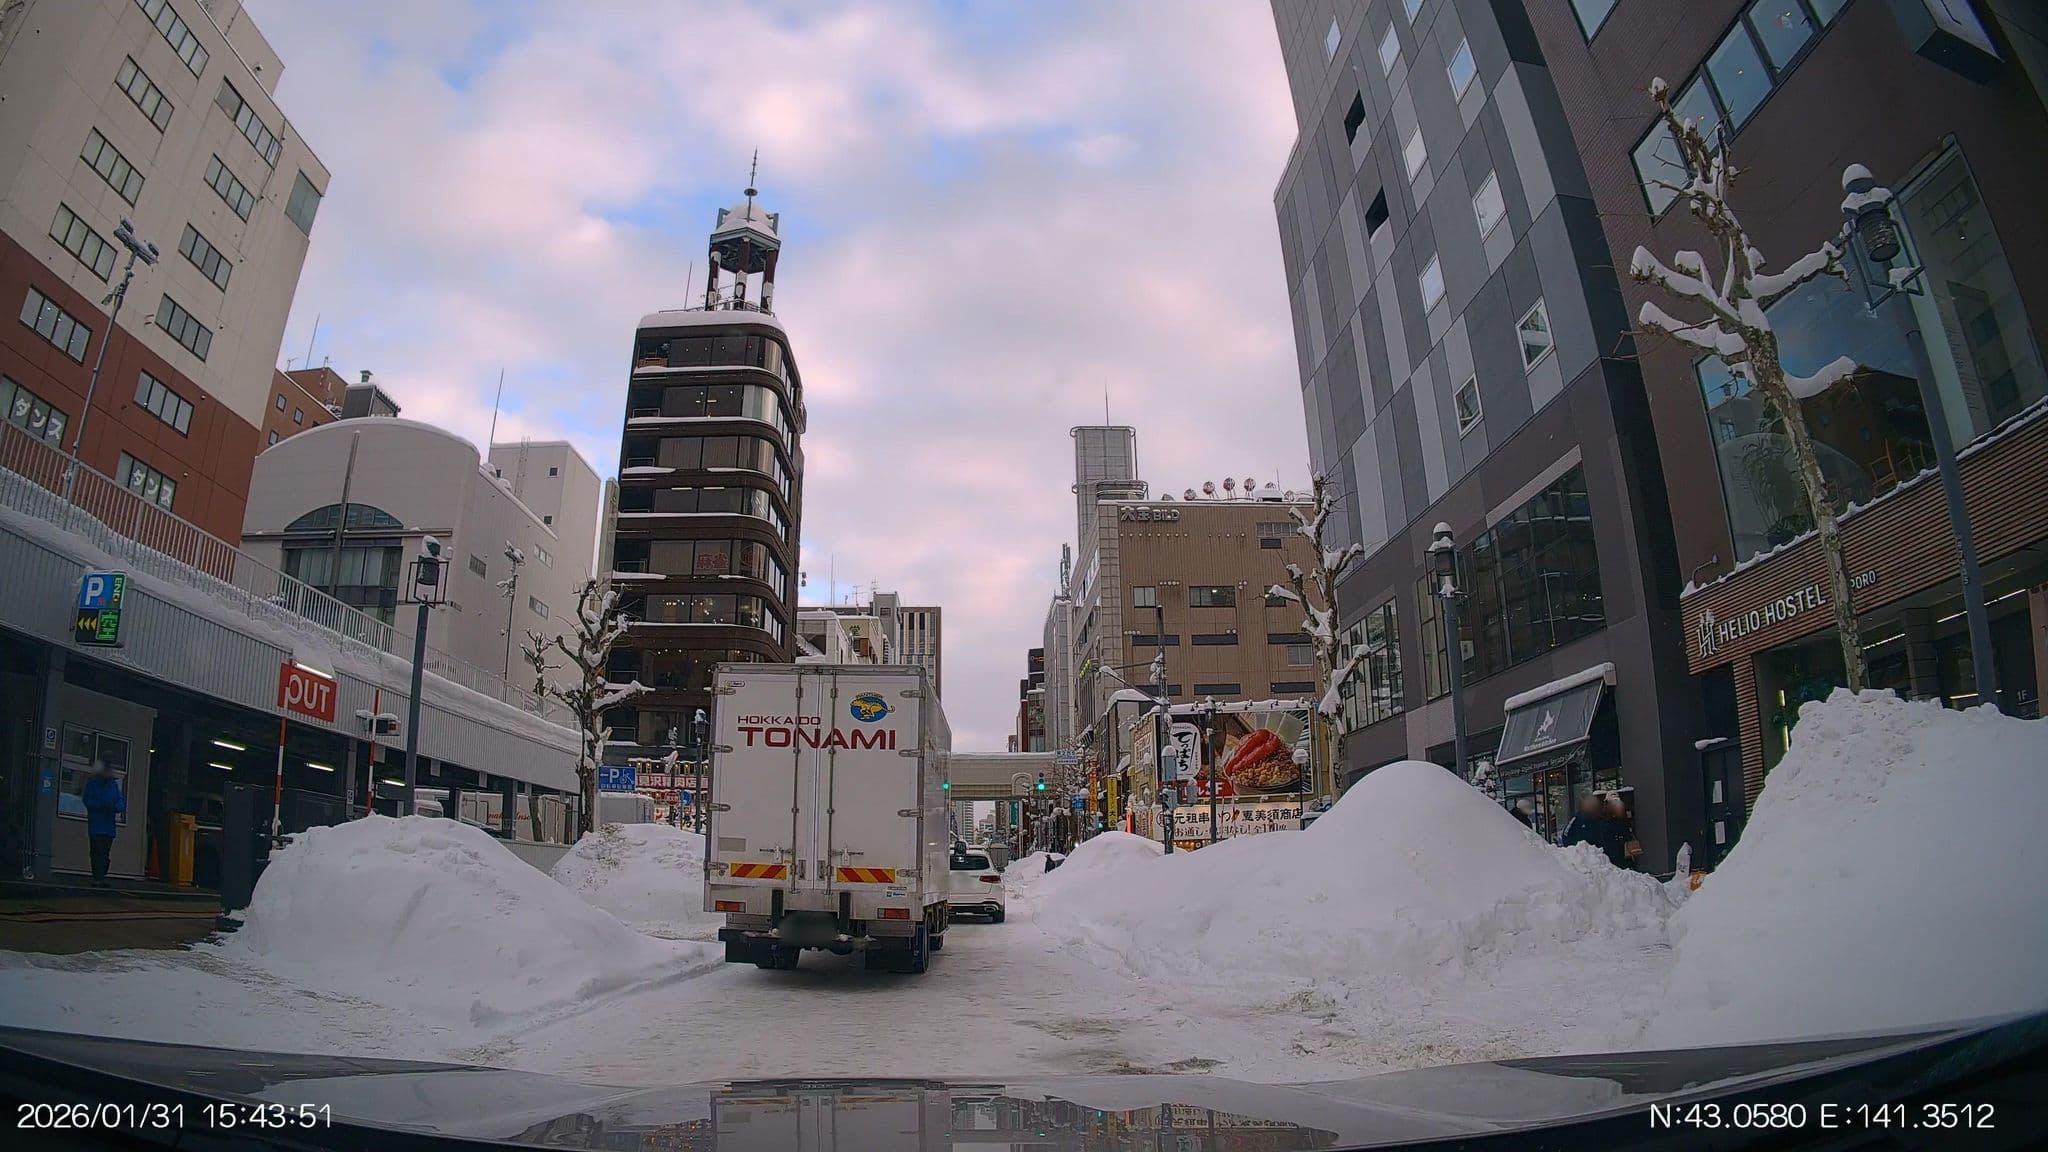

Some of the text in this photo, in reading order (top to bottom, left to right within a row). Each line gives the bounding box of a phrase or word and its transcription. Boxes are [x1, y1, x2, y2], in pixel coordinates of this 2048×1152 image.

[84, 576, 104, 606] P
[1719, 610, 1760, 644] HELIO
[1765, 584, 1826, 626] HOSTEL
[288, 674, 330, 713] OUT
[2017, 691, 2028, 701] 1F
[737, 715, 821, 726] HOKKAIDO
[737, 726, 896, 750] TONAMI
[609, 768, 620, 783] P
